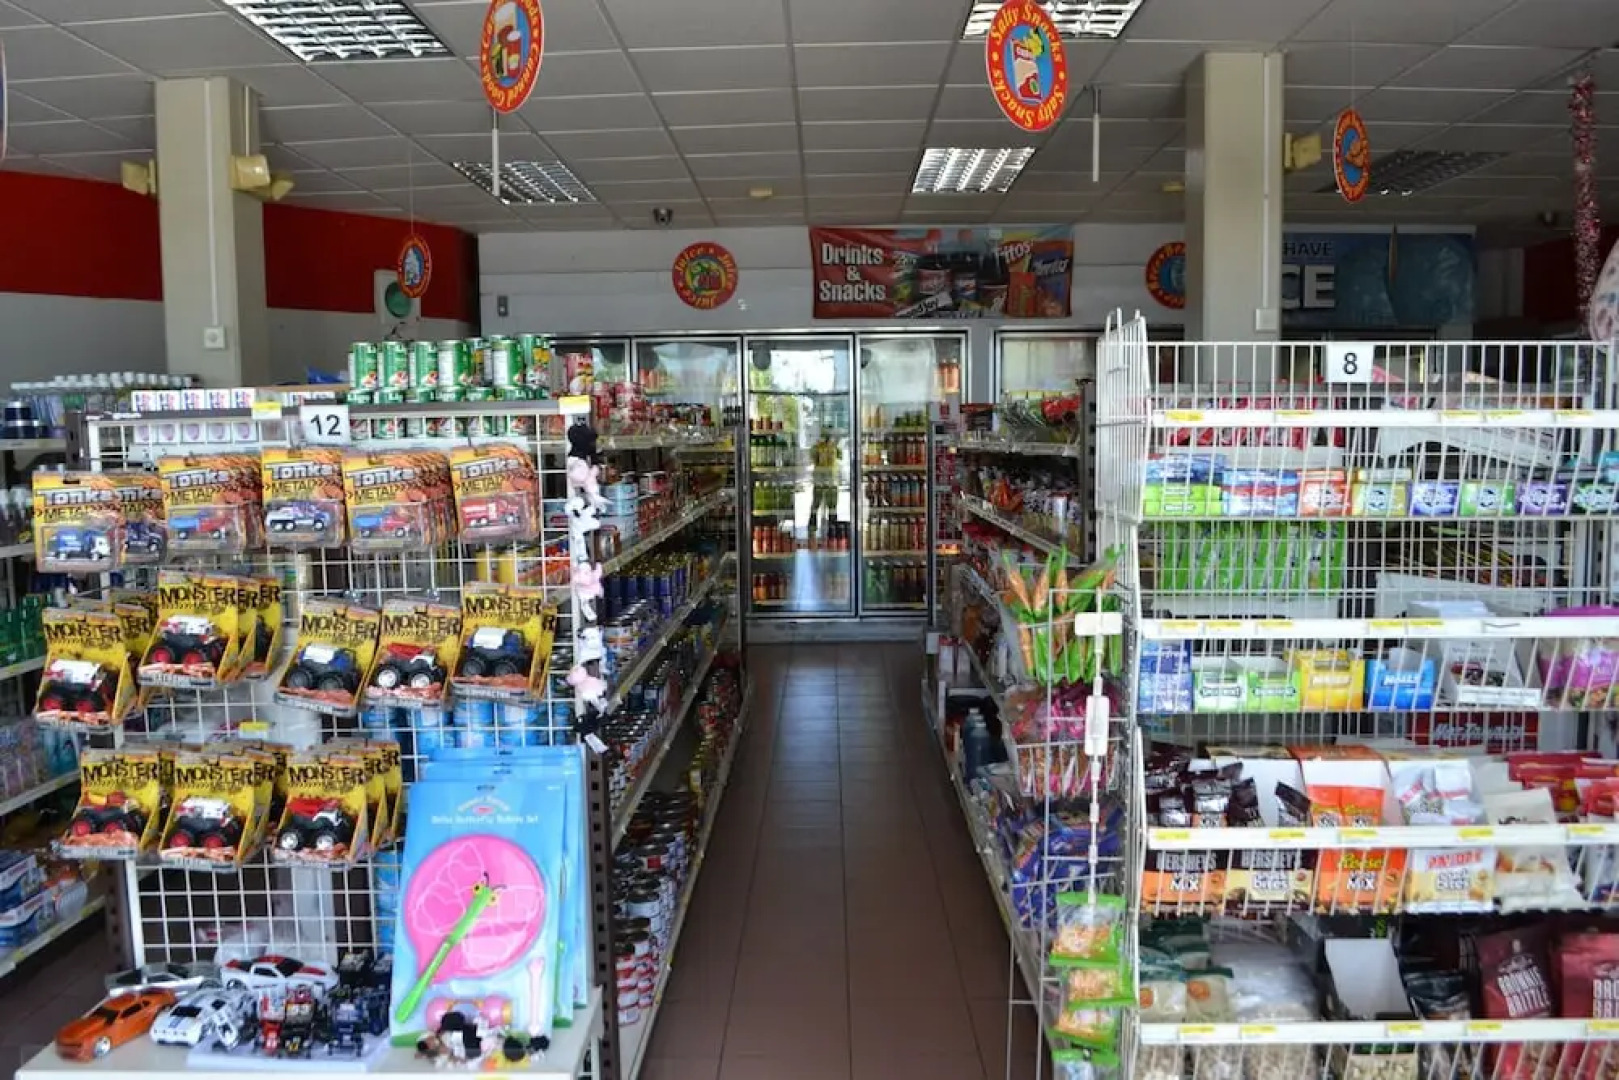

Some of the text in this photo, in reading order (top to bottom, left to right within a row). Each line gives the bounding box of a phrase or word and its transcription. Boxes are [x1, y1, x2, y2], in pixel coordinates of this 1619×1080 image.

[991, 3, 1062, 62] Salty Snacks
[992, 70, 1064, 128] Salty Snacks
[821, 242, 883, 265] Drinks
[1285, 242, 1333, 256] HAVE
[846, 266, 861, 281] &
[818, 280, 887, 302] Snacks
[1281, 264, 1335, 309] CE
[1342, 351, 1359, 375] 8
[310, 414, 341, 435] 12
[162, 468, 231, 487] Tonka
[264, 462, 334, 480] Tonka
[346, 468, 418, 488] Tonka
[454, 457, 519, 478] Tonka
[158, 585, 236, 605] MONSTER
[466, 596, 541, 616] MONSTER
[44, 622, 123, 642] MONSTER
[302, 614, 377, 638] MONSTER
[384, 614, 461, 634] MONSTER
[83, 761, 158, 782] MONSTER
[176, 766, 256, 785] MONSTER
[289, 764, 365, 785] MONSTER
